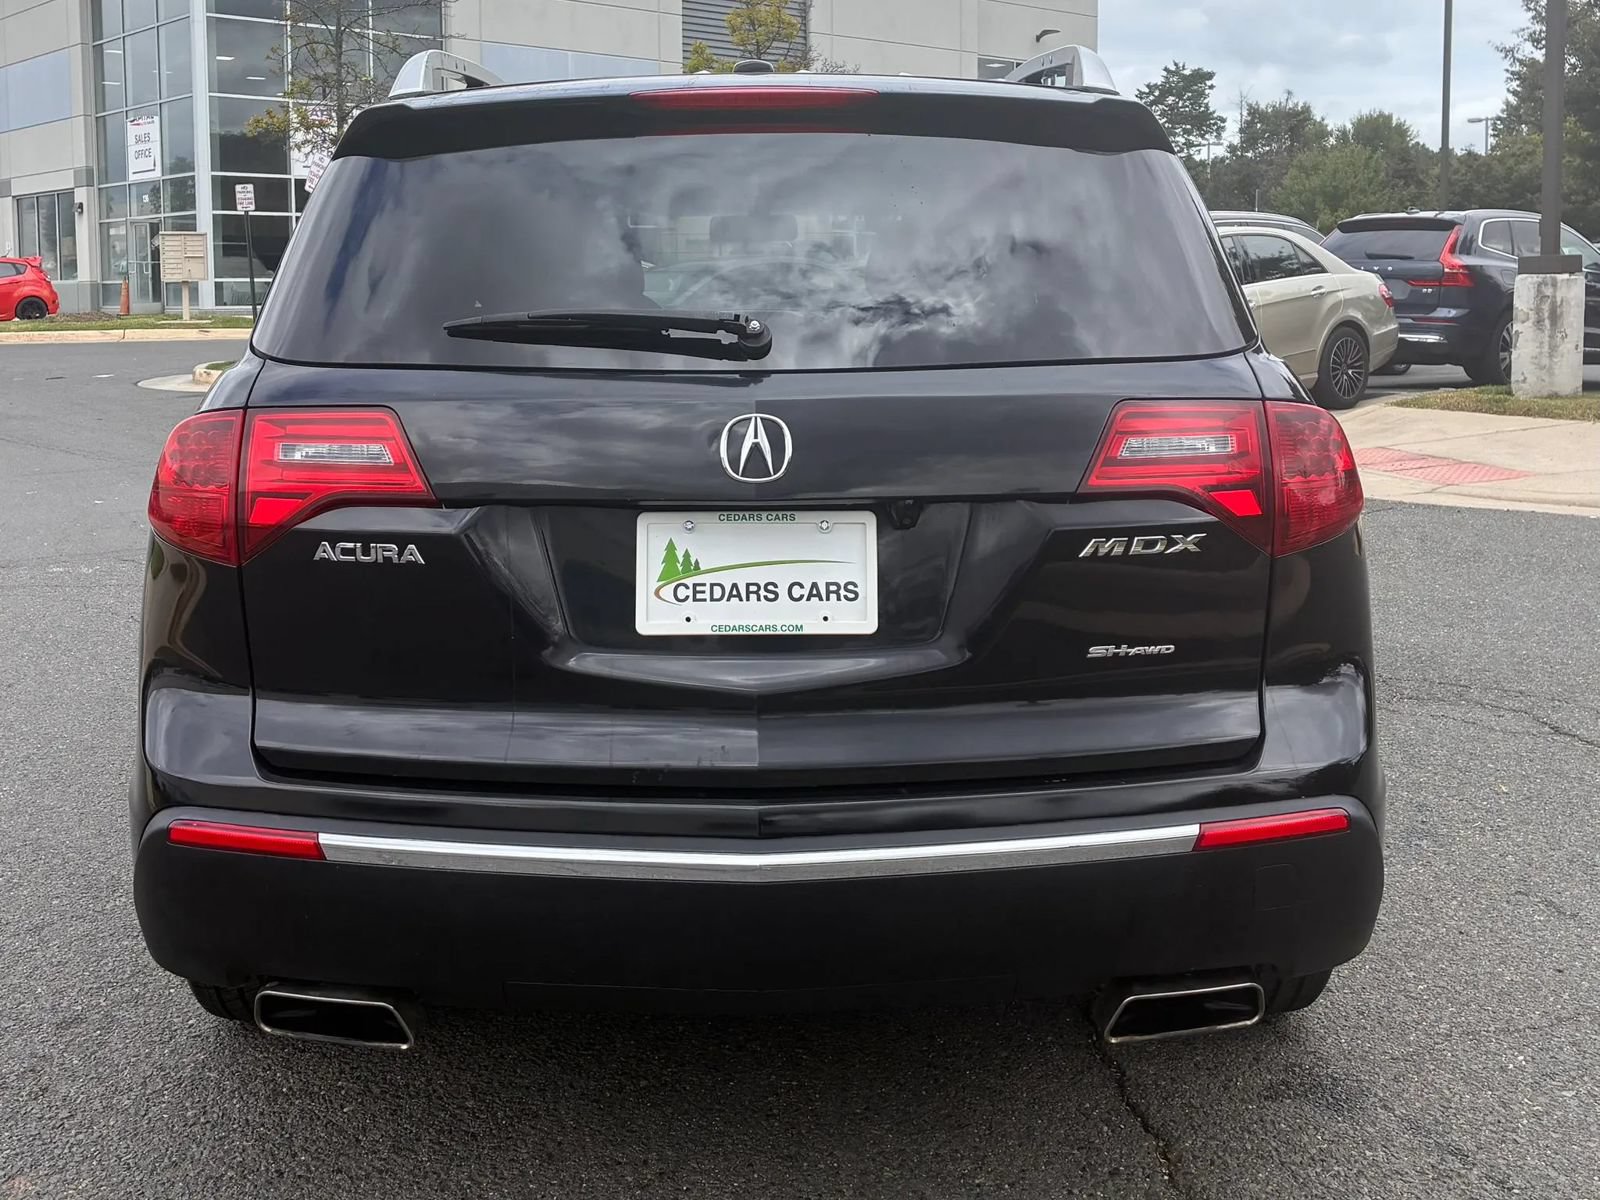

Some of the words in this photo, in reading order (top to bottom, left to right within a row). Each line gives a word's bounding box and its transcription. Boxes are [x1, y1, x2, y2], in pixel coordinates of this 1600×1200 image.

[134, 132, 151, 145] SALES
[134, 148, 152, 160] OFFICE
[718, 513, 763, 522] CEDARS
[766, 513, 796, 522] CARS
[1078, 533, 1207, 558] MDX
[313, 541, 426, 564] ACURA
[672, 581, 780, 603] CEDARS
[787, 581, 860, 603] CARS
[710, 624, 804, 633] CEDARSCARS.COM
